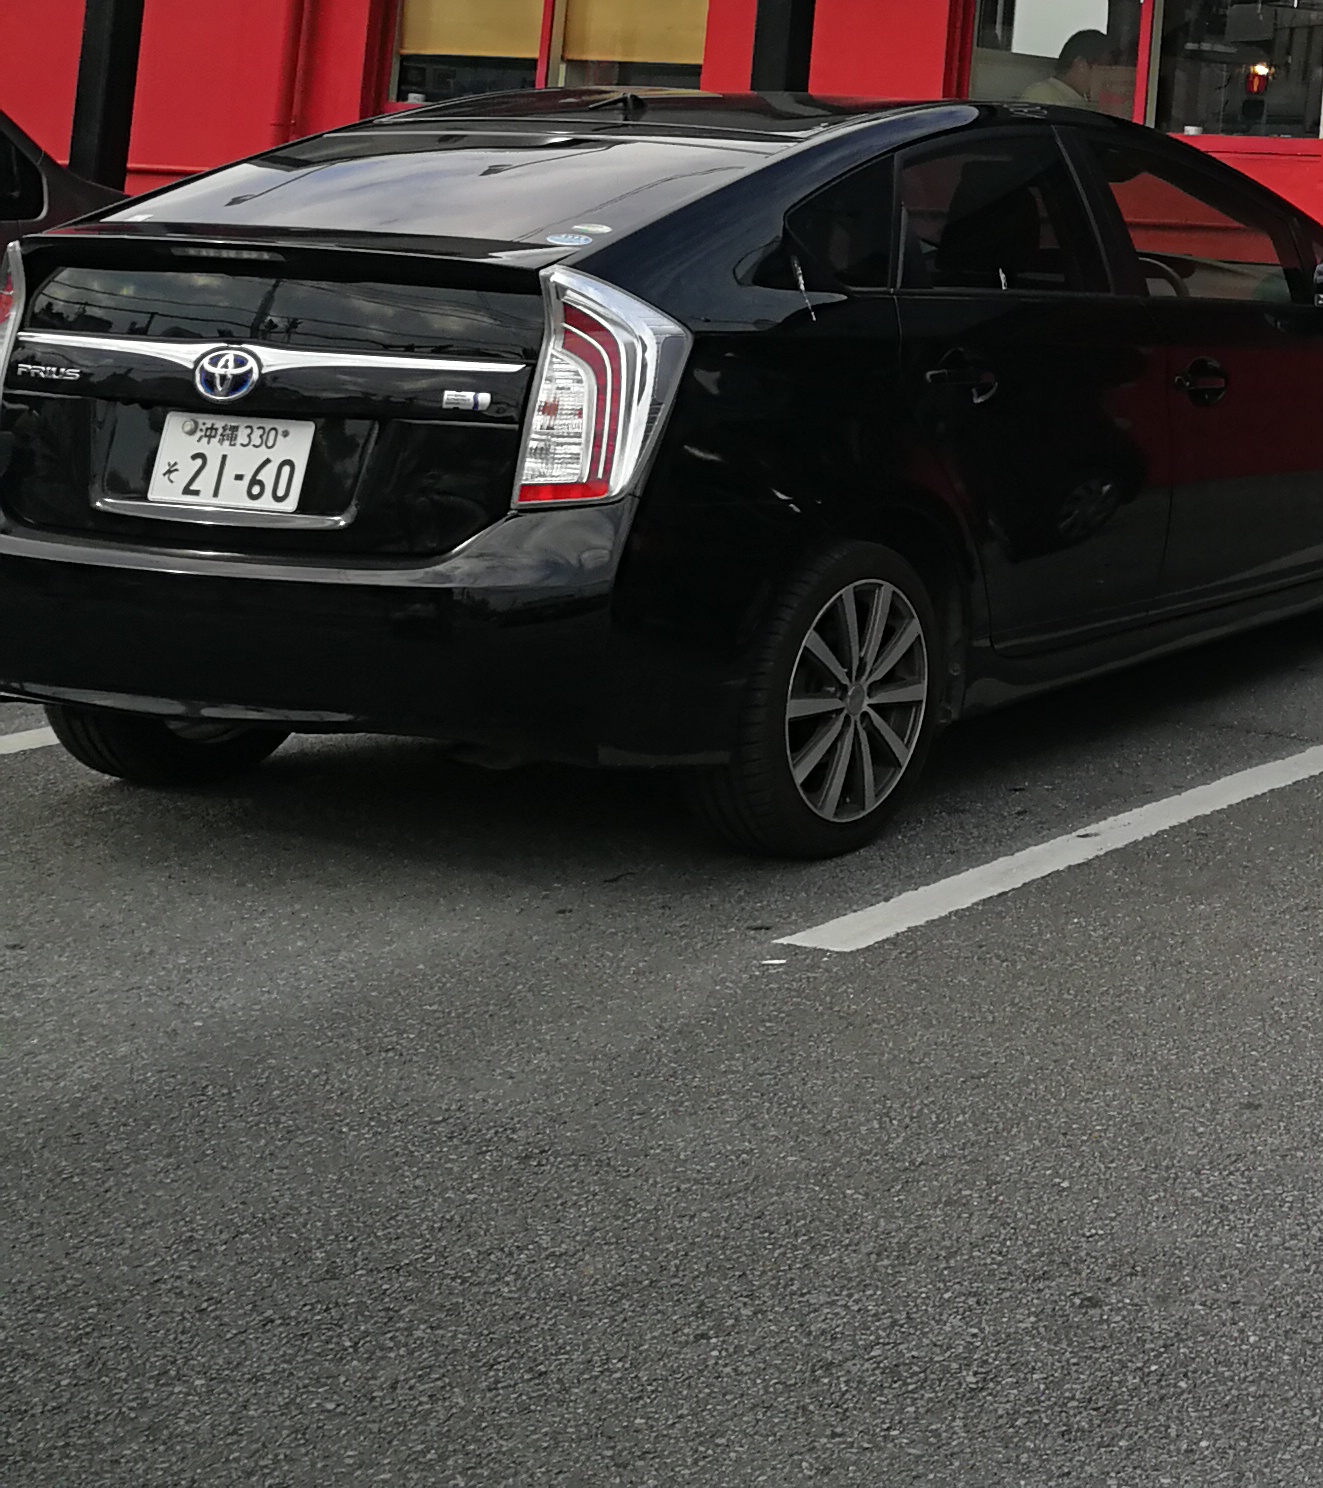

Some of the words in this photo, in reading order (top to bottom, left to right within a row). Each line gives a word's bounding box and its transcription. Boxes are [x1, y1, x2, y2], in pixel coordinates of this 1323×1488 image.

[17, 363, 81, 380] PRIUS
[162, 460, 180, 484] そ
[181, 451, 296, 503] 21-60
